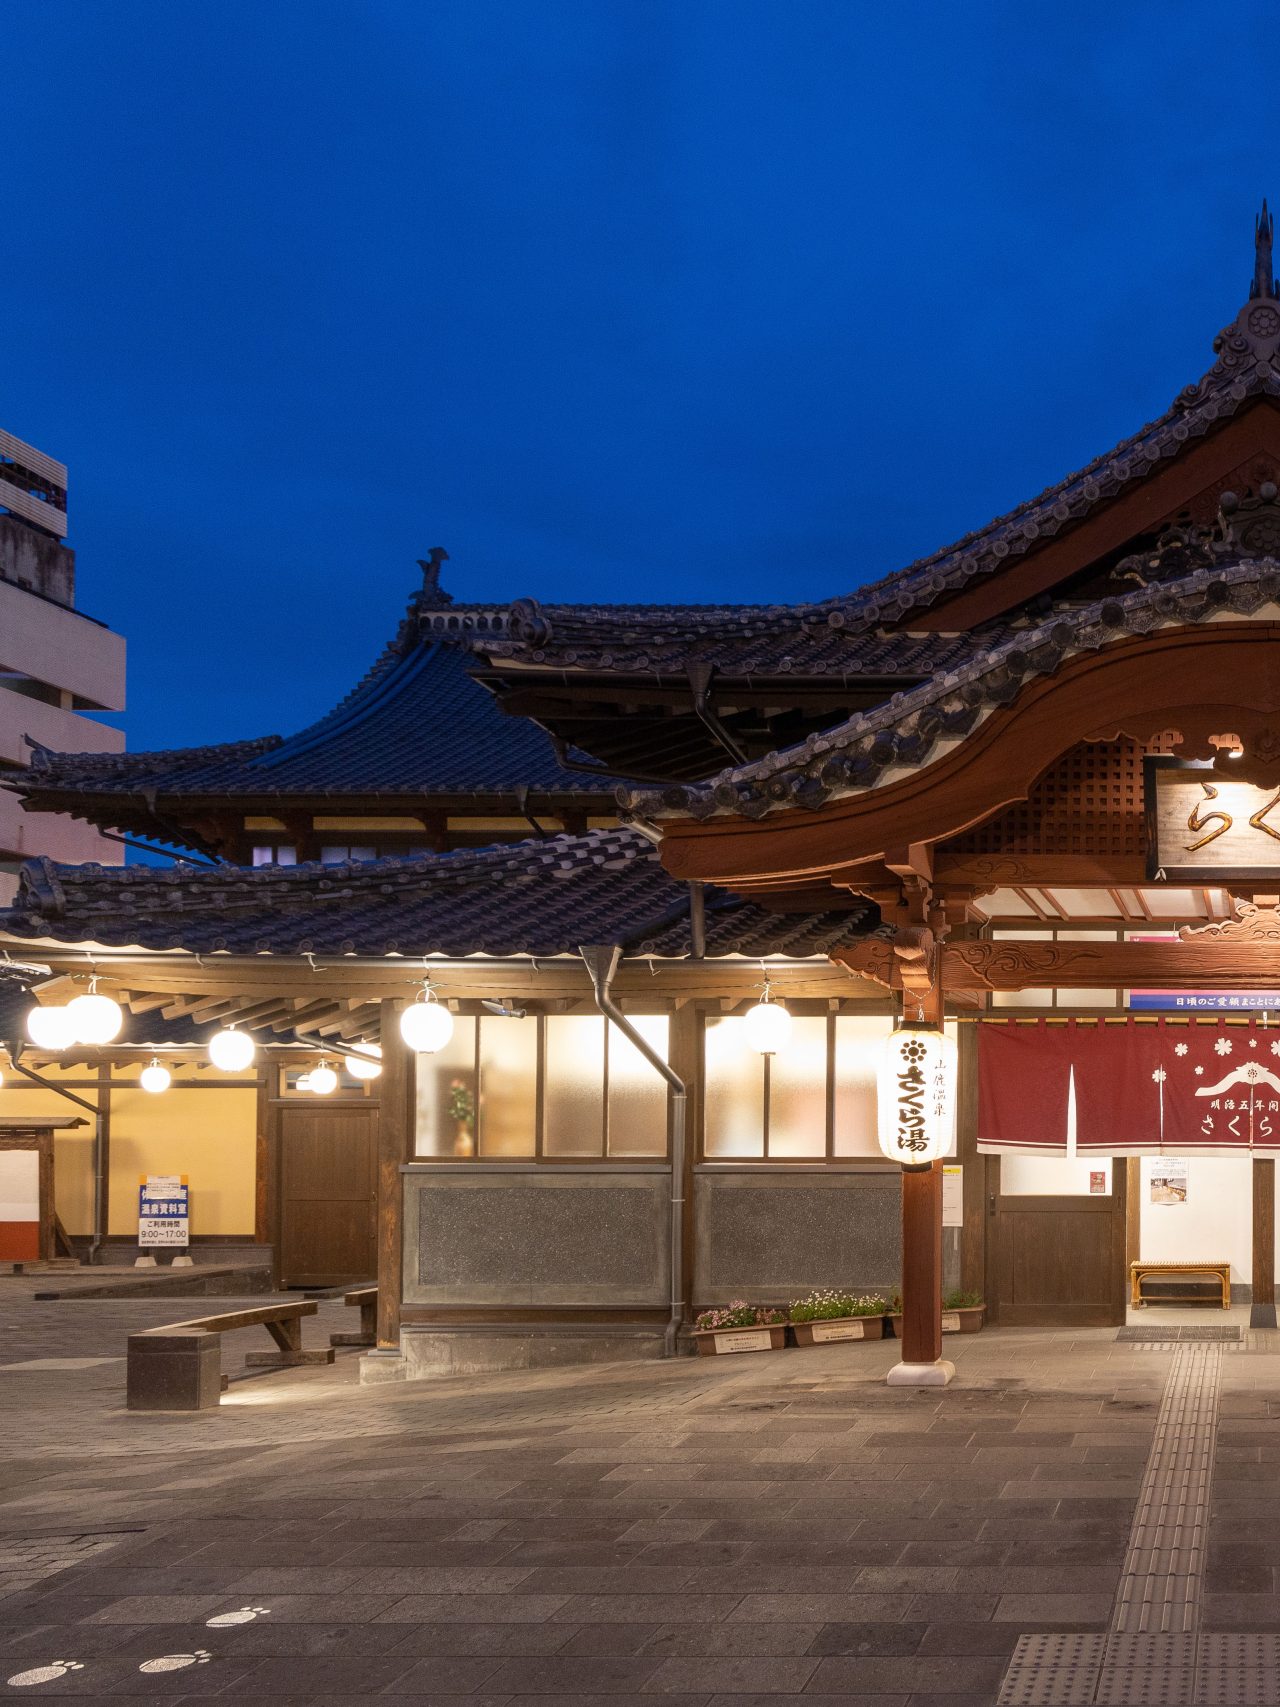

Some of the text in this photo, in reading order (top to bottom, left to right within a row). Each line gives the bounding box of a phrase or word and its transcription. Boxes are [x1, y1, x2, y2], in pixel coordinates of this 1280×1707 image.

[933, 1059, 947, 1117] 山鹿温泉
[896, 1065, 931, 1153] さくら湯
[141, 1203, 187, 1215] 温泉資料室
[147, 1220, 180, 1229] ご利用時間
